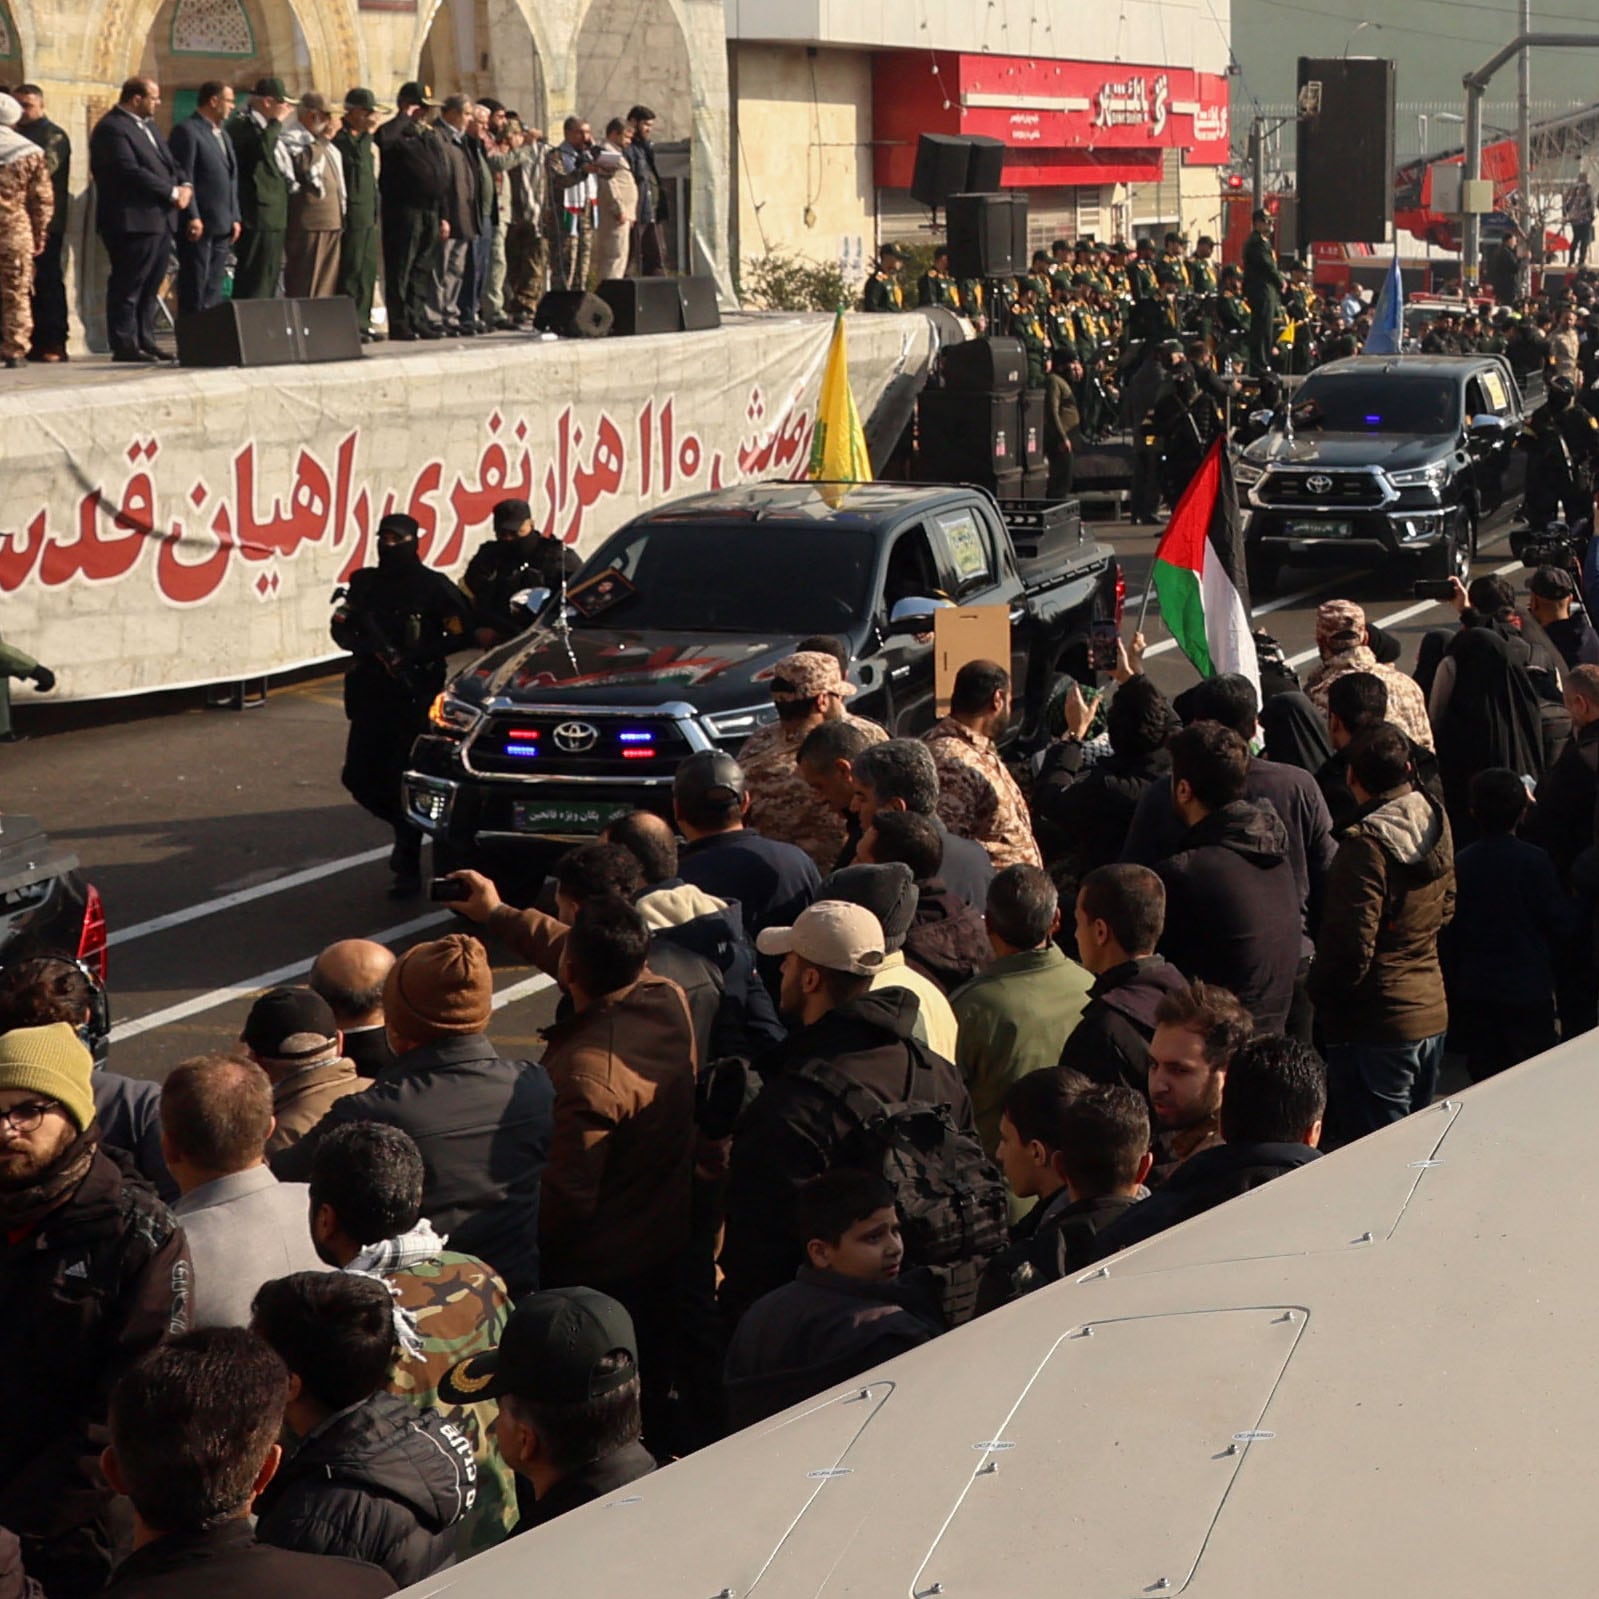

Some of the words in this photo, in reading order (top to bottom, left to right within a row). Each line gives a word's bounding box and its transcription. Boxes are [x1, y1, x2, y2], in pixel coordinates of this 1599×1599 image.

[158, 429, 369, 602] راهیان
[382, 412, 532, 567] نفری
[542, 406, 623, 545] هزار
[640, 392, 701, 499] ۱۱۰
